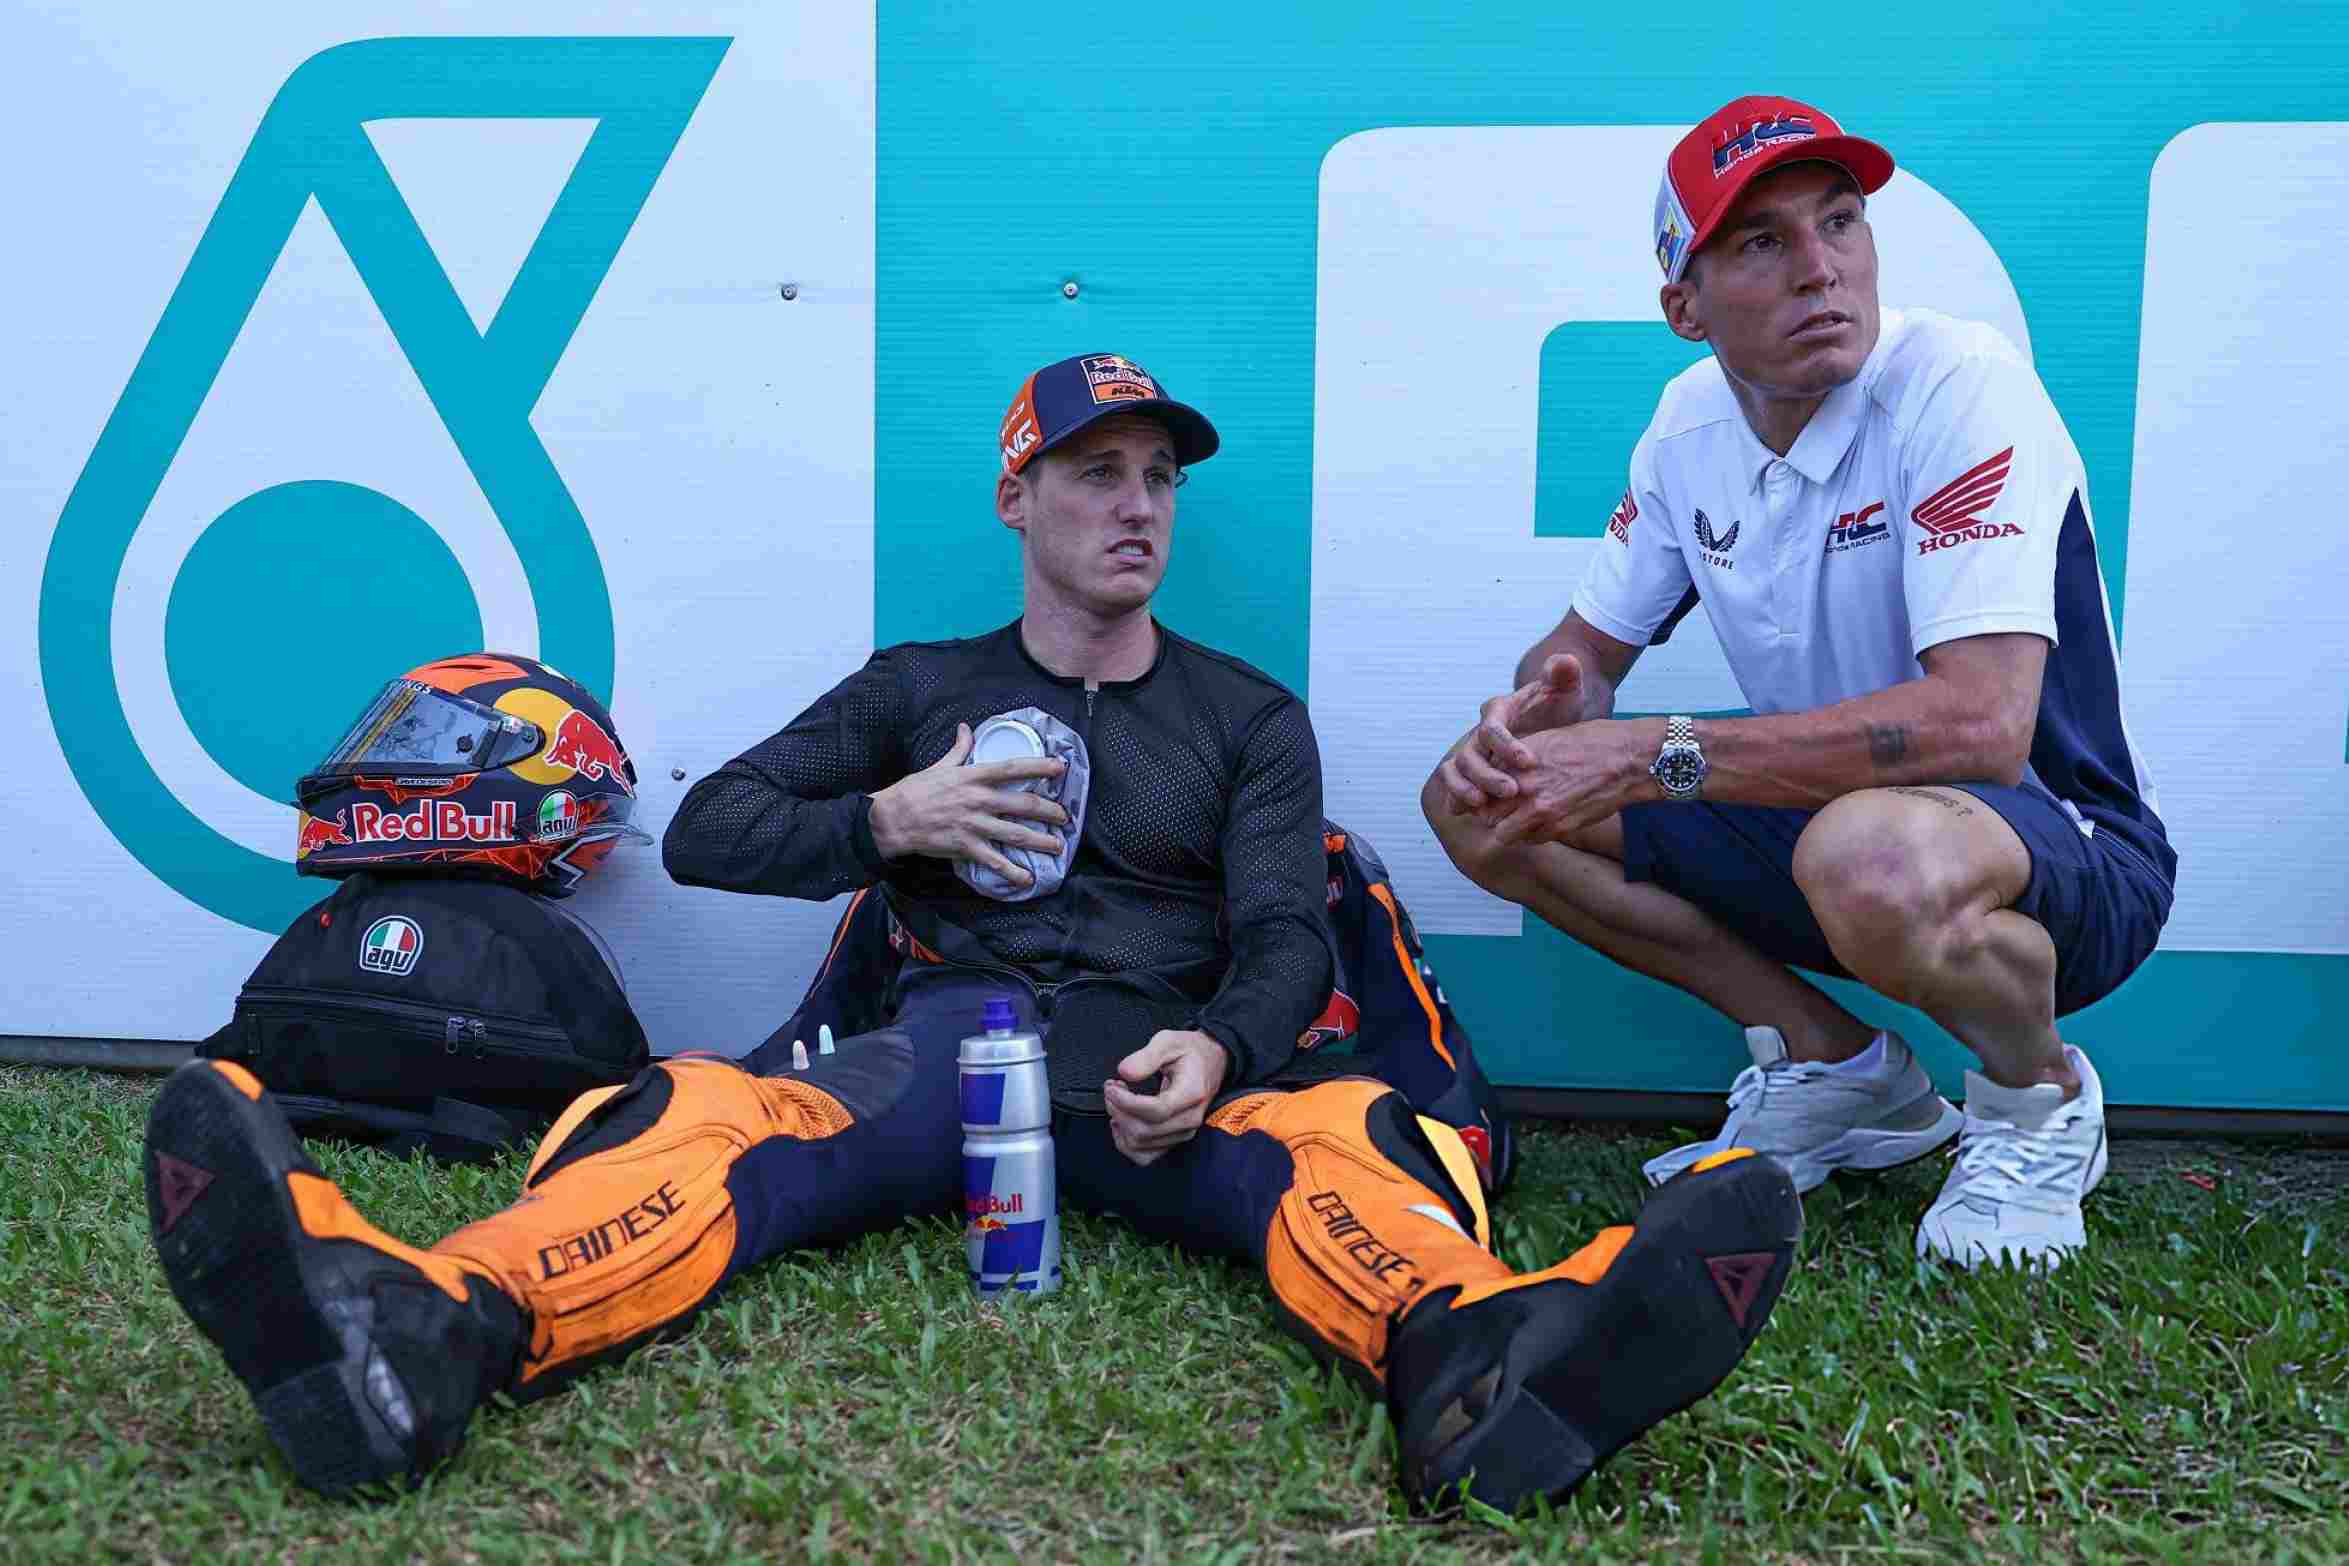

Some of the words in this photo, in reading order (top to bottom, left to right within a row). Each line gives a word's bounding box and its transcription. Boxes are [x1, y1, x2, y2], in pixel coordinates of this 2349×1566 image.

[1917, 522, 2025, 556] HONDA
[352, 799, 432, 843] Red
[437, 800, 516, 841] Bull
[366, 947, 411, 971] agv
[991, 1193, 1023, 1213] Bull
[538, 1180, 687, 1281] DAINESE
